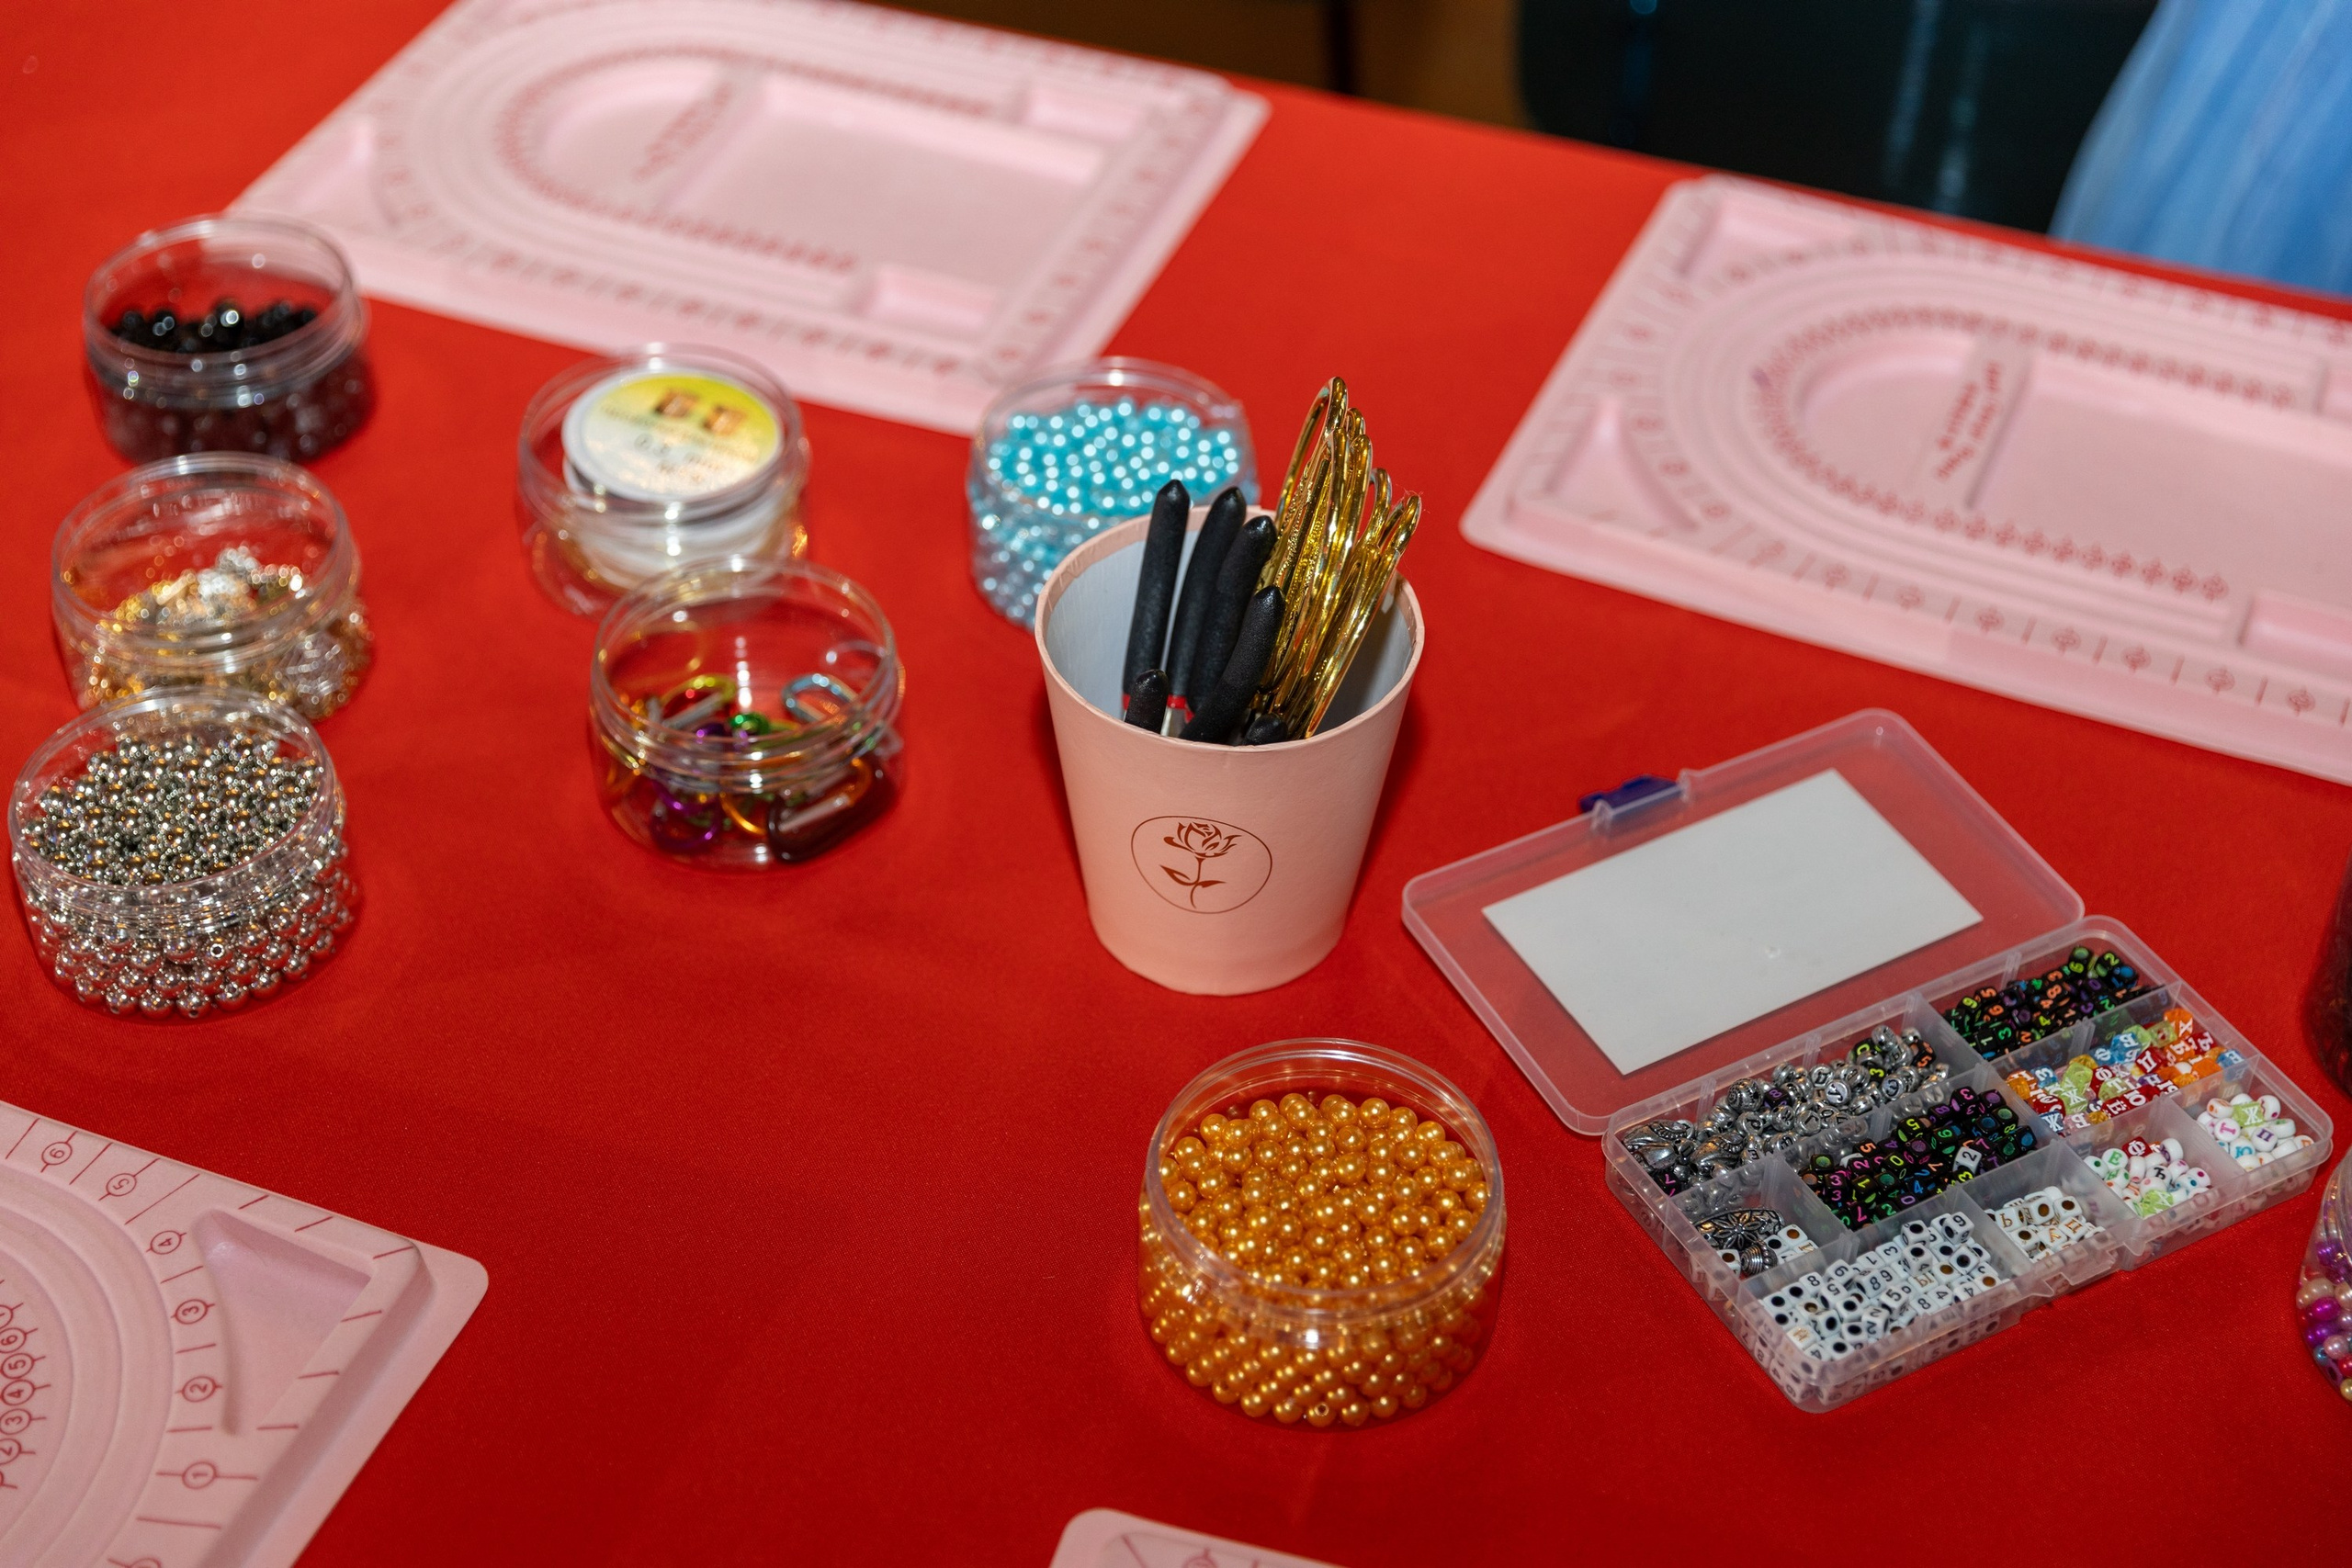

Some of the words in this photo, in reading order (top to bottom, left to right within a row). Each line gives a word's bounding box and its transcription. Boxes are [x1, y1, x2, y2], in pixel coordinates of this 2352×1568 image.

[2103, 953, 2120, 966] 2
[2046, 984, 2063, 999] 8
[2099, 998, 2115, 1011] 2
[1997, 1027, 2012, 1040] 3
[1917, 1055, 1932, 1068] 5
[1869, 1067, 1885, 1077] 3
[1768, 1089, 1782, 1098] 8
[1960, 1089, 1974, 1100] 3
[1934, 1105, 1951, 1114] 8
[2241, 1105, 2265, 1127] Ж
[1905, 1118, 1921, 1131] 5
[2004, 1123, 2017, 1134] 8
[2041, 1112, 2064, 1133] Ж
[1860, 1142, 1877, 1154] 5
[2127, 1139, 2146, 1156] Ф
[1889, 1155, 1905, 1167] 0
[1962, 1151, 1977, 1162] 2
[1853, 1159, 1871, 1169] 2
[1829, 1174, 1843, 1187] 3
[1958, 1171, 1973, 1182] 3
[1914, 1179, 1924, 1193] 4
[1831, 1190, 1842, 1201] 3
[1900, 1195, 1916, 1205] 0
[1881, 1203, 1897, 1217] 2
[1883, 1246, 1899, 1257] 3
[1806, 1275, 1821, 1287] 8
[1870, 1276, 1882, 1291] 8
[1826, 1283, 1841, 1296] 5
[1885, 1288, 1902, 1302] 5
[1963, 1287, 1974, 1298] 4
[1936, 1291, 1949, 1301] 4
[1917, 1298, 1931, 1310] 8
[1809, 1348, 1823, 1360] 4
